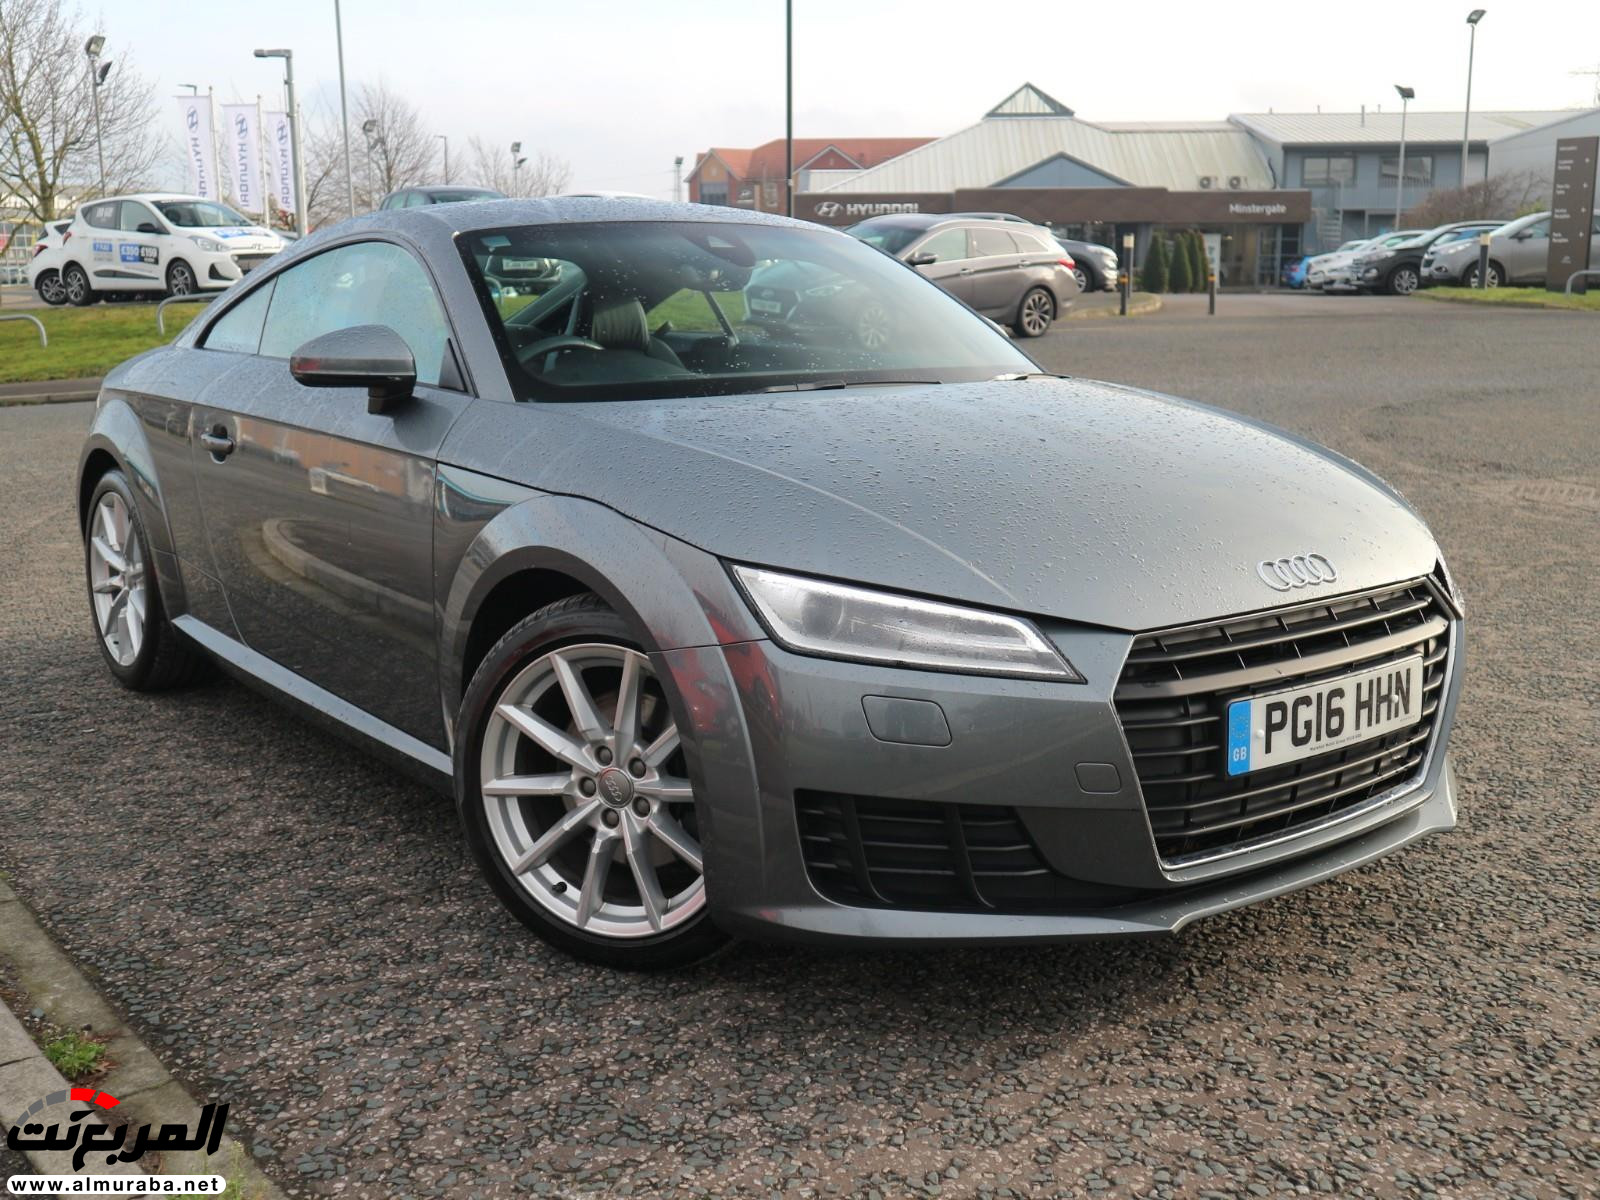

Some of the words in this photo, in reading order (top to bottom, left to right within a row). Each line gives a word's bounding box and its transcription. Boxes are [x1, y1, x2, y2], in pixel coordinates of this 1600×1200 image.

[846, 203, 919, 216] HYUNDAI
[1229, 203, 1287, 216] Minstergate
[1264, 687, 1345, 755] PG16
[1355, 668, 1411, 731] HHN
[1233, 746, 1247, 761] GB
